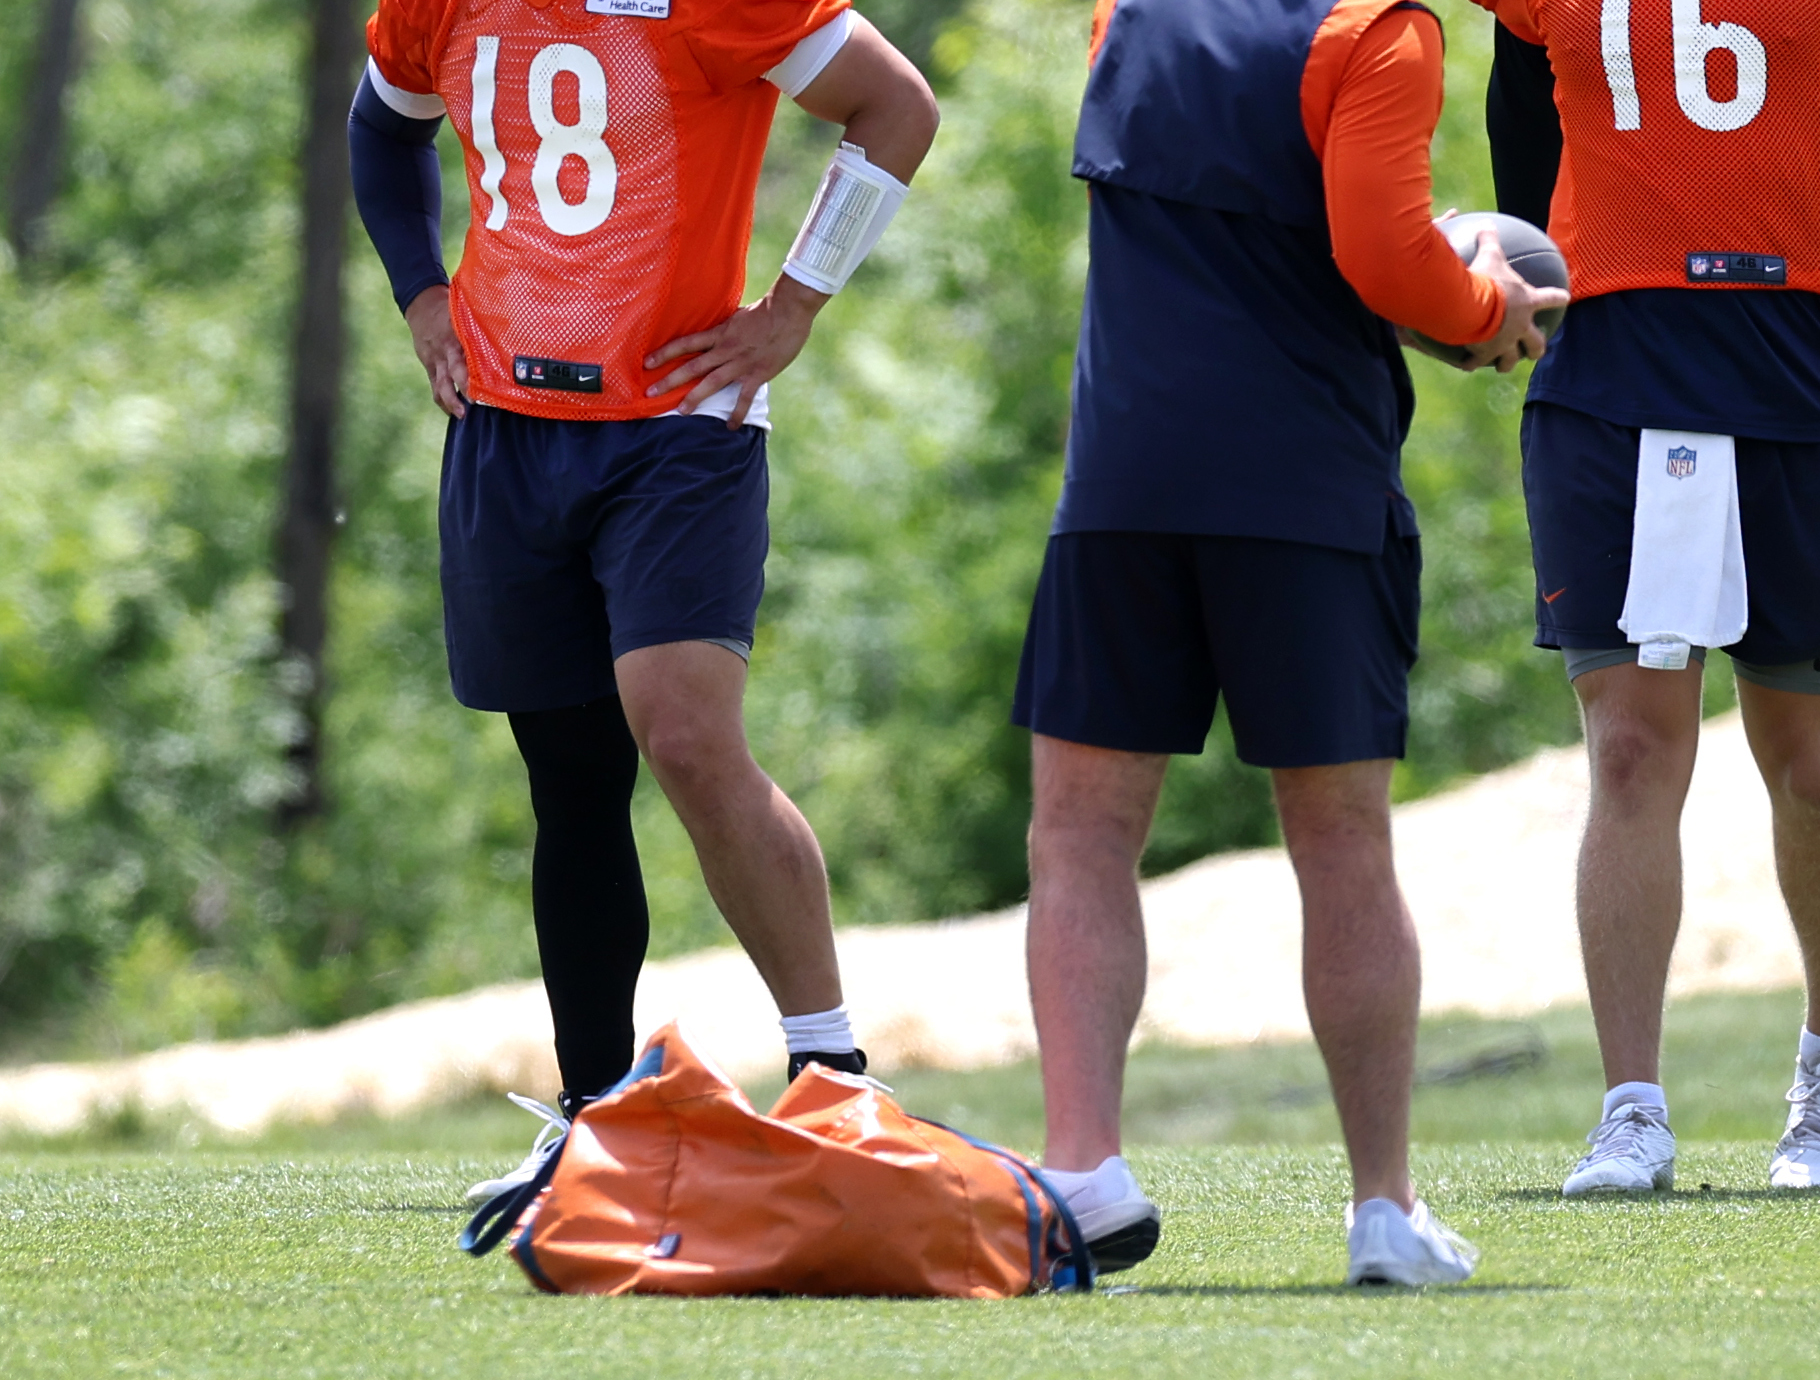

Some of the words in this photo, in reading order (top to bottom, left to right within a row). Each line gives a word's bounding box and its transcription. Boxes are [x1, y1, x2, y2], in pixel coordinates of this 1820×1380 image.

[609, 1, 638, 11] Health
[640, 2, 665, 14] Care
[471, 36, 618, 237] 18
[1670, 459, 1693, 476] NFL
